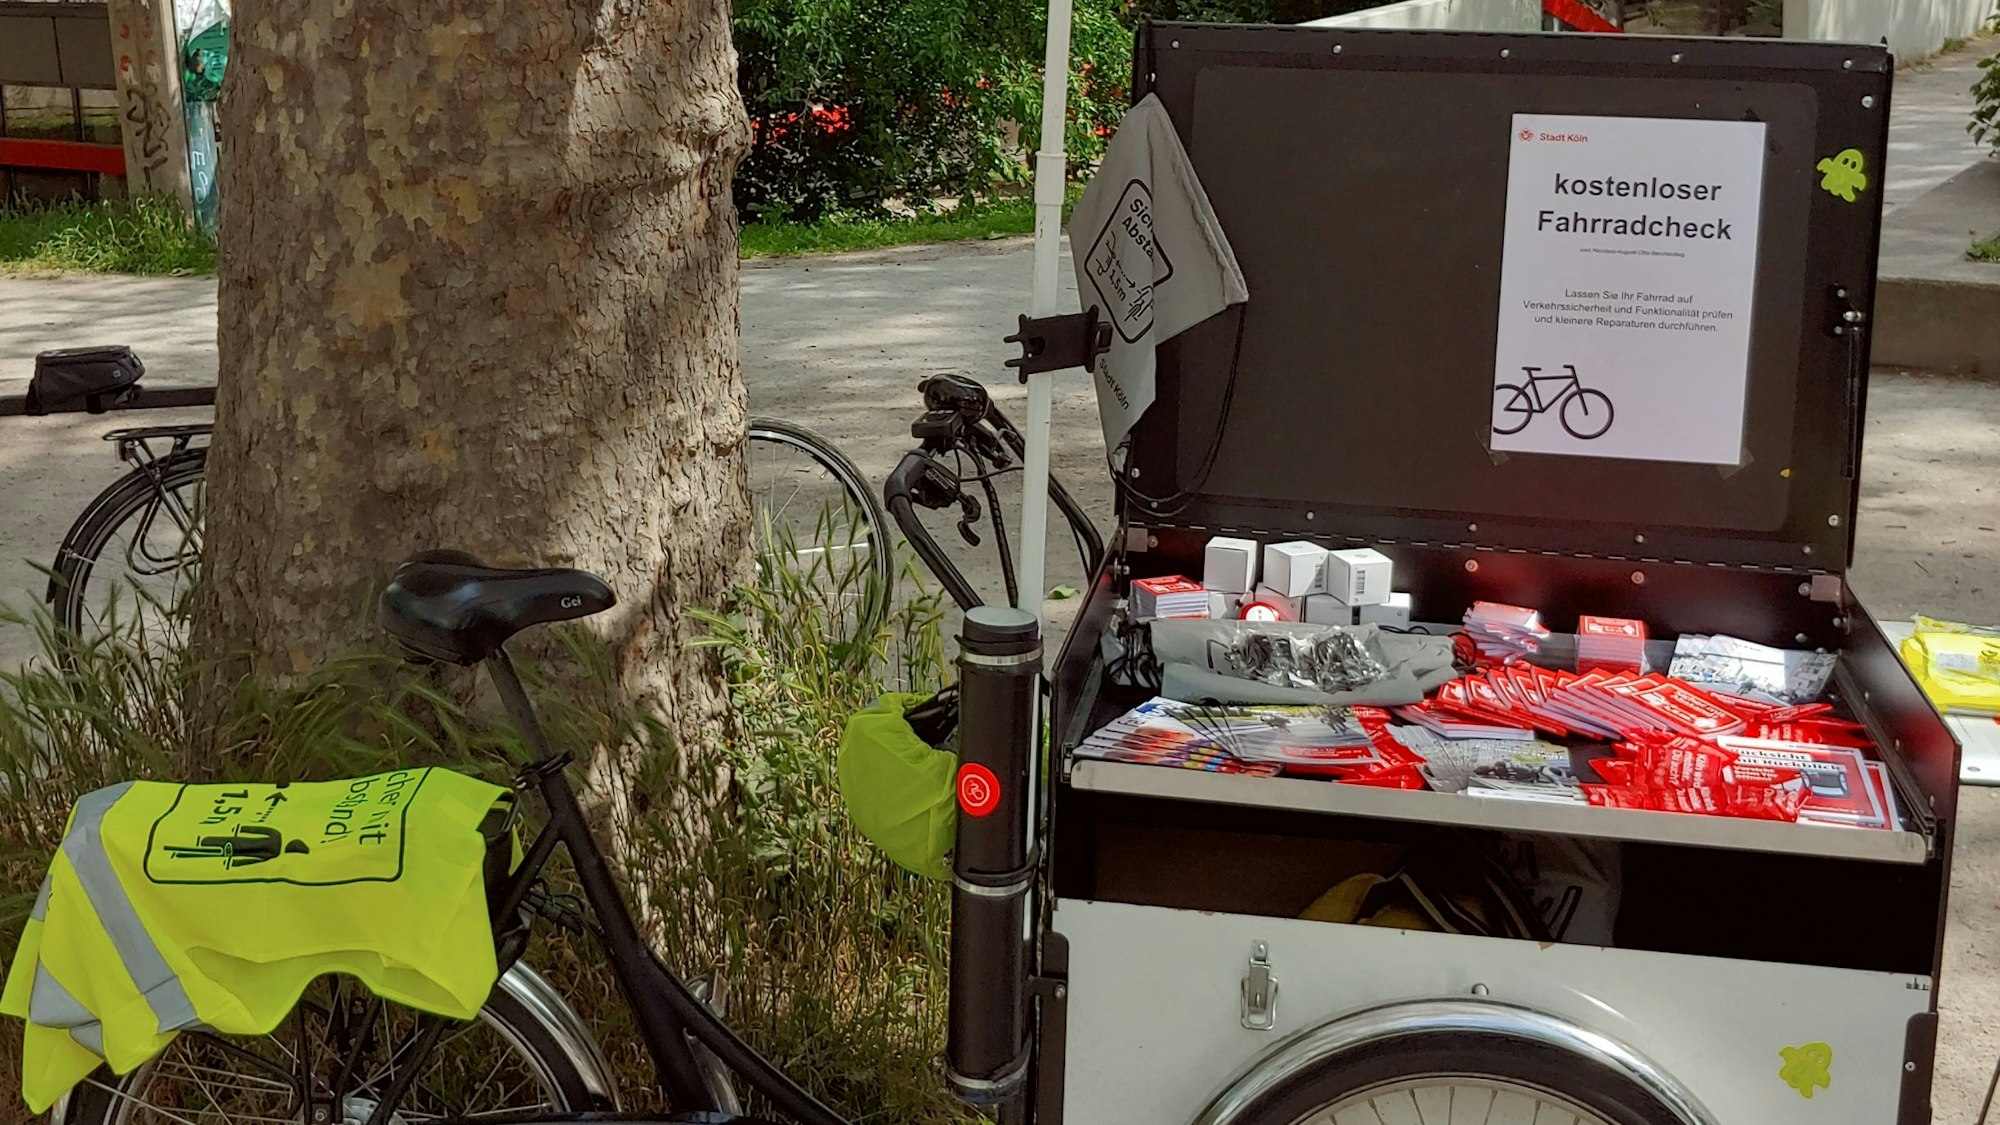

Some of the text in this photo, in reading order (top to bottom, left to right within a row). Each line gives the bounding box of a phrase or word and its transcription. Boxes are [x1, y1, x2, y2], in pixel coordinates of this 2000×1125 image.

[1540, 132, 1588, 143] Stadt Köln
[1554, 173, 1722, 201] kostenloser
[1537, 210, 1732, 240] Fahrradcheck
[1122, 216, 1154, 262] Absta
[1109, 269, 1127, 302] 1,5m
[1565, 289, 1693, 304] Lassen Sie Ihr Fahrrad auf
[1523, 300, 1733, 320] Verkehrssicherheit und Funktionalität prüfen
[1534, 314, 1719, 333] und kleinere Reparaturen durchführen.
[560, 595, 583, 608] Gel
